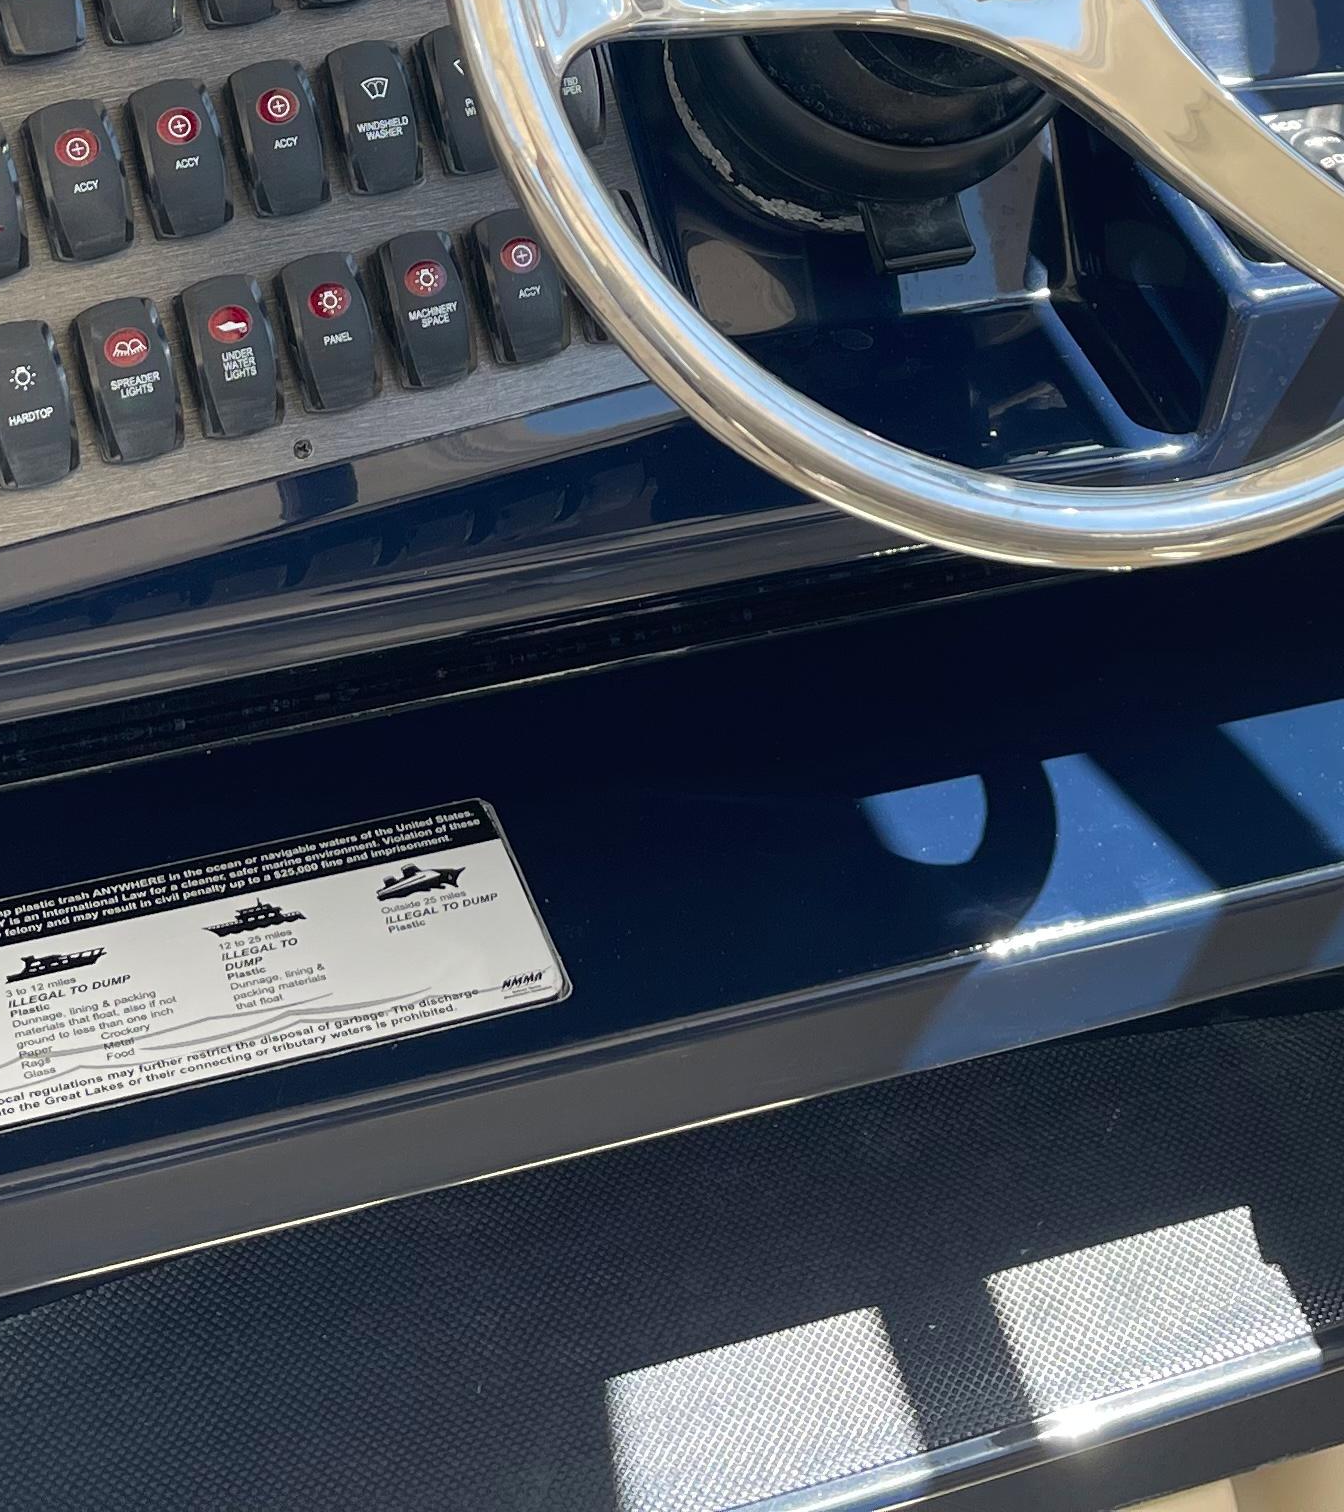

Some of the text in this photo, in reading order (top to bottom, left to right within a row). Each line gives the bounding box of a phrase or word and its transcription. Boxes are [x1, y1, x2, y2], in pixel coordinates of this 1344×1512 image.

[562, 84, 582, 97] IPER
[356, 115, 409, 134] WINDSHIELD
[365, 125, 403, 141] WASHER
[273, 135, 298, 150] ACCY
[175, 156, 200, 170] ACCY
[73, 179, 99, 194] ACCY
[518, 284, 541, 299] ACCY
[408, 301, 459, 322] MACHINERY
[421, 313, 450, 329] SPACE
[323, 331, 353, 347] PANEL
[221, 346, 254, 362] UNDER
[223, 356, 256, 372] WATER
[110, 370, 161, 392] SPREADER
[224, 366, 258, 382] LIGHTS
[120, 382, 154, 399] LIGHTS
[8, 406, 54, 427] HARDTOP
[14, 899, 55, 916] plastic
[58, 892, 89, 905] trash
[92, 876, 165, 899] ANYWHERE
[168, 872, 180, 882] in
[183, 867, 203, 878] the
[206, 860, 242, 874] ocean
[244, 855, 257, 864] or
[260, 843, 316, 862] navigable
[318, 834, 357, 850] waters
[360, 830, 373, 840] of
[375, 825, 394, 837] the
[396, 817, 433, 832] United
[435, 809, 475, 823] States.
[385, 893, 498, 925] ILLEGAL TO DUMP
[388, 919, 426, 934] Plastic
[221, 937, 298, 961] ILLEGAL TO
[225, 956, 263, 972] DUMP
[227, 966, 266, 981] Plastic
[8, 974, 131, 1008] ILLEGAL TO DUMP
[10, 1003, 50, 1018] Plastic
[29, 1074, 103, 1098] regulations
[107, 1068, 134, 1082] may
[139, 1056, 182, 1073] further
[187, 1045, 233, 1063] restrict
[235, 1038, 256, 1050] the
[260, 1026, 314, 1045] disposal
[318, 1021, 331, 1031] of
[392, 1003, 416, 1016] The
[418, 988, 479, 1009] discharge
